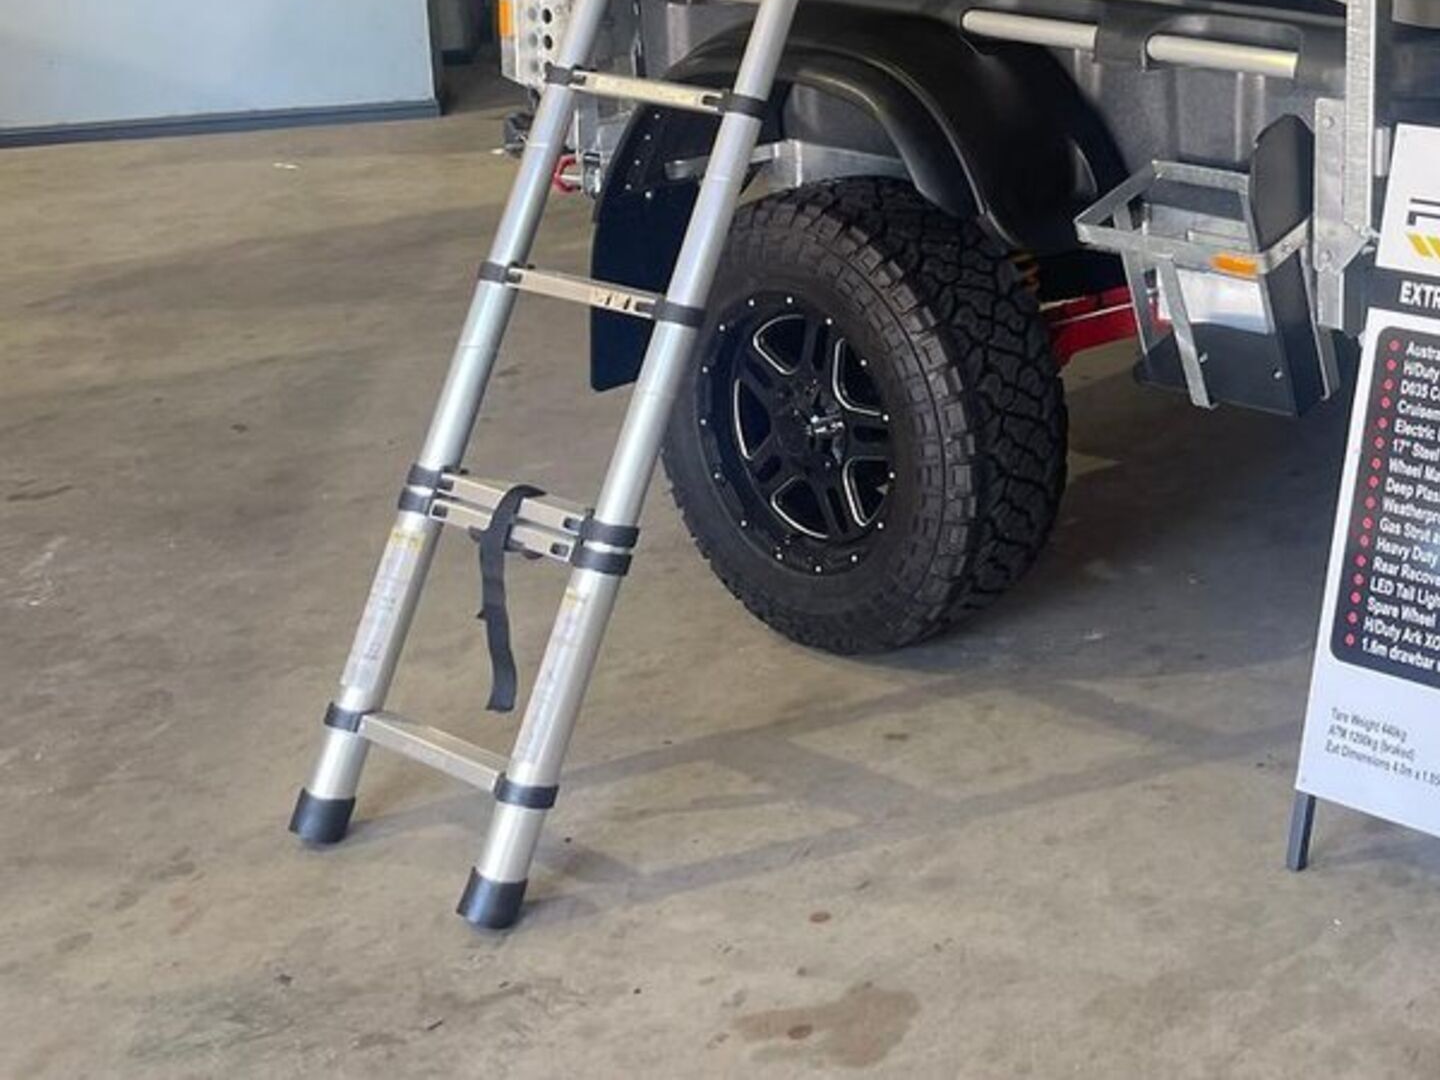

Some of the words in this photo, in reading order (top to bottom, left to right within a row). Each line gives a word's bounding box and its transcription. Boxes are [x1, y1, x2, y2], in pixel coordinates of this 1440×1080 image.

[1394, 418, 1435, 440] Electric
[1411, 441, 1440, 461] Steel
[1388, 457, 1422, 478] Wheel
[1385, 477, 1414, 499] Deep
[1379, 517, 1401, 535] Gas
[1376, 536, 1410, 560] Heavy
[1411, 545, 1438, 568] Duty
[1372, 556, 1399, 576] Rear
[1369, 576, 1394, 595] LED
[1396, 582, 1415, 601] Tail
[1367, 596, 1399, 618] Spare
[1401, 605, 1436, 627] Wheel
[1402, 627, 1422, 645] Ark
[1389, 645, 1434, 669] drawbar
